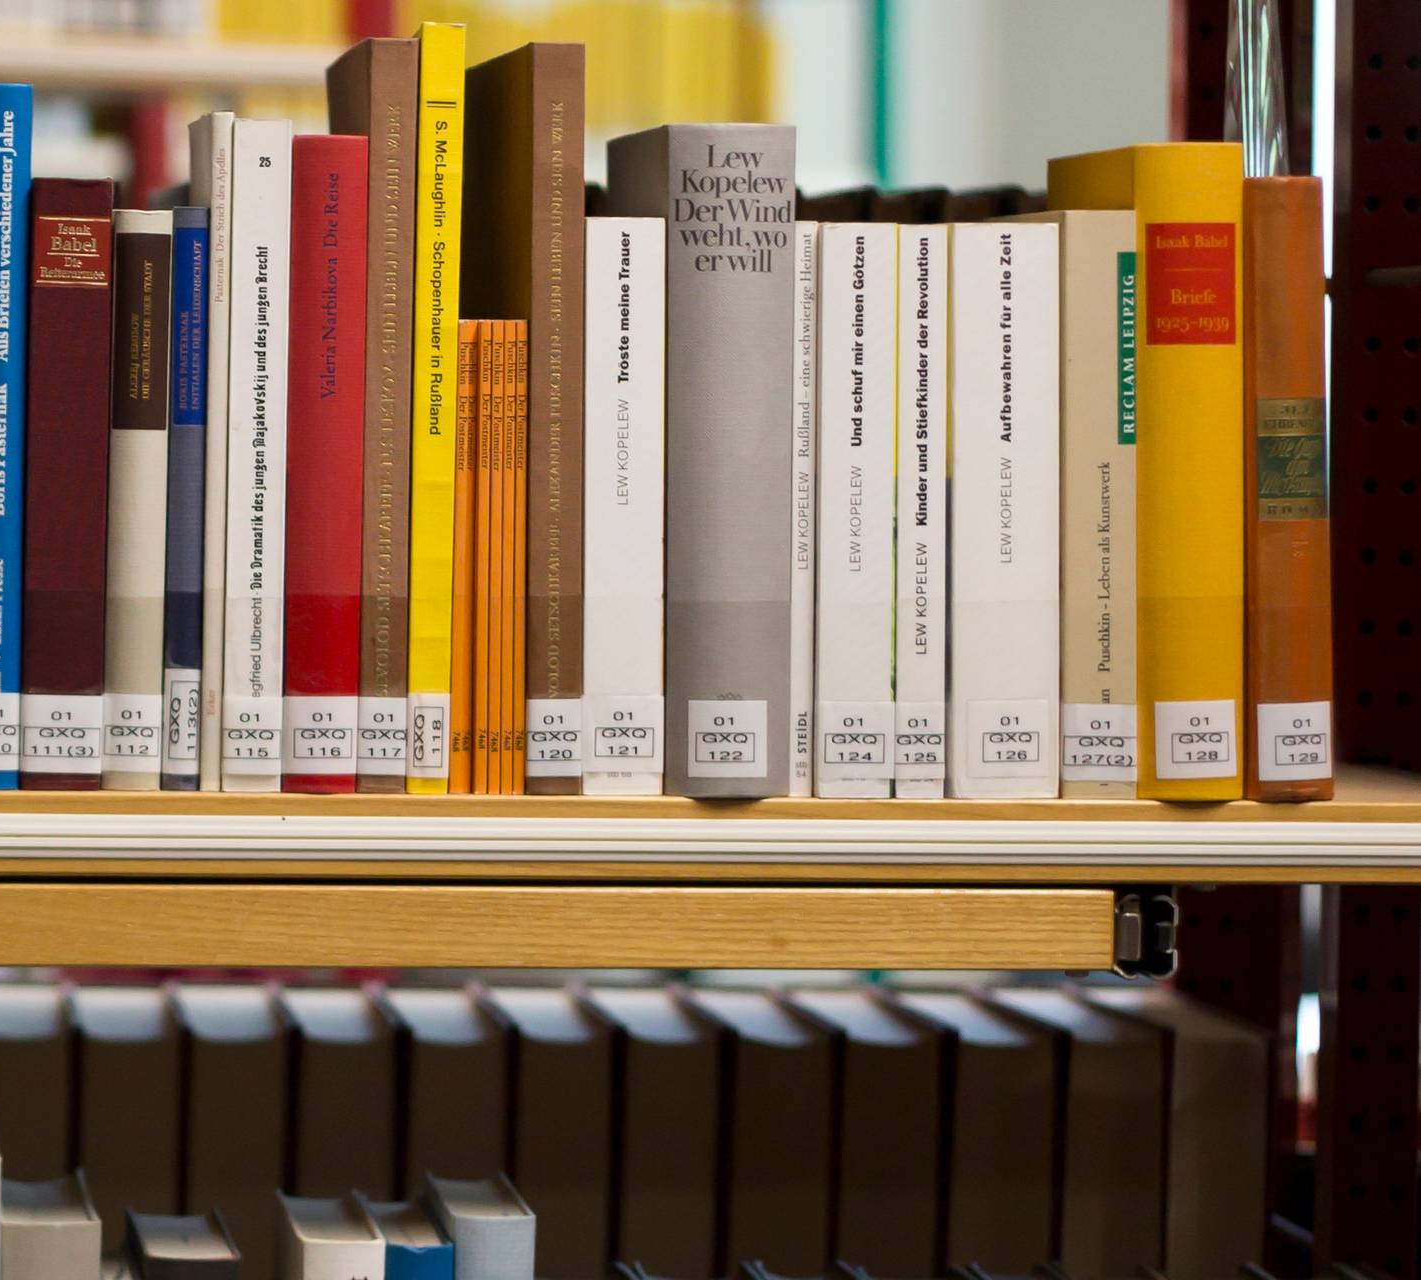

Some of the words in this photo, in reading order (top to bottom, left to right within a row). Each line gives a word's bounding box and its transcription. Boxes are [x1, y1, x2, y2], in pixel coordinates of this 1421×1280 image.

[435, 121, 446, 134] S.
[259, 156, 272, 168] 25
[706, 144, 763, 168] Lew
[323, 173, 339, 215] Reise
[432, 140, 447, 227] McLaughlin
[681, 168, 786, 198] Kopelew
[674, 199, 724, 223] Der
[725, 199, 791, 224] Wind
[50, 236, 97, 252] Babel
[58, 223, 91, 236] Isaak
[322, 221, 338, 249] Die
[680, 223, 751, 250] weht,
[754, 229, 786, 248] wo
[1156, 235, 1190, 249] Isaak
[1194, 235, 1228, 248] Babel
[64, 257, 82, 268] Die
[619, 232, 630, 280] Trauer
[695, 253, 723, 272] er
[728, 249, 771, 273] will
[800, 233, 812, 282] Heimat
[853, 236, 865, 290] Götzen
[1000, 234, 1012, 266] Zeit
[917, 238, 930, 320] Revolution
[1001, 270, 1012, 300] alle
[255, 286, 269, 326] jungen
[321, 258, 338, 340] Narbikova
[429, 240, 446, 351] Schopenhauer
[618, 284, 630, 331] meine
[1170, 288, 1217, 305] Briefe
[799, 286, 815, 357] schwierige
[853, 294, 864, 338] einen
[1000, 304, 1012, 329] für
[1123, 274, 1135, 350] LEIPZIG
[254, 329, 267, 348] des
[917, 323, 929, 349] der
[254, 350, 267, 372] und
[431, 355, 442, 367] in
[618, 335, 629, 384] Tröste
[852, 341, 864, 366] mir
[321, 346, 337, 400] Valeria
[800, 360, 811, 388] eine
[1000, 334, 1012, 442] Aufbewahren
[429, 373, 443, 435] Rußland
[851, 369, 863, 413] schuf
[917, 354, 929, 440] Stiefkinder
[1122, 357, 1135, 434] RECLAM
[617, 399, 629, 470] KOPELEW
[798, 402, 810, 458] Rußland
[851, 418, 863, 447] Und
[252, 451, 267, 490] jungen
[917, 444, 929, 473] und
[252, 493, 264, 512] des
[617, 474, 629, 506] LEW
[797, 472, 809, 538] KOPELEW
[850, 466, 862, 537] KOPELEW
[916, 477, 928, 527] Kinder
[1000, 458, 1012, 529] KOPELEW
[1098, 462, 1111, 533] Kunstwerk
[250, 515, 264, 569] Dramatik
[798, 541, 809, 571] LEW
[849, 541, 861, 572] LEW
[1000, 532, 1012, 564] LEW
[1098, 537, 1111, 553] als
[916, 542, 927, 618] KOPELEW
[1097, 556, 1111, 601] Leben
[249, 597, 262, 652] Ulbrecht
[916, 622, 927, 655] LEW
[1097, 613, 1111, 673] Puschkin
[29, 745, 94, 758] 111(3)
[114, 744, 150, 755] 112
[431, 719, 442, 755] 118
[531, 731, 578, 743] GXQ
[606, 745, 640, 756] 121
[701, 733, 749, 745] GXQ
[831, 734, 879, 746] GXQ
[895, 734, 943, 746] GXQ
[233, 747, 269, 758] 115
[306, 747, 341, 758] 116
[366, 747, 403, 758] 117
[538, 749, 573, 760] 120
[708, 750, 744, 761] 122
[837, 751, 872, 762] 124
[902, 751, 937, 763] 125
[994, 750, 1028, 761] 126
[1069, 754, 1133, 766] 127(2)
[1185, 750, 1218, 761] 128
[1288, 752, 1319, 763] 129
